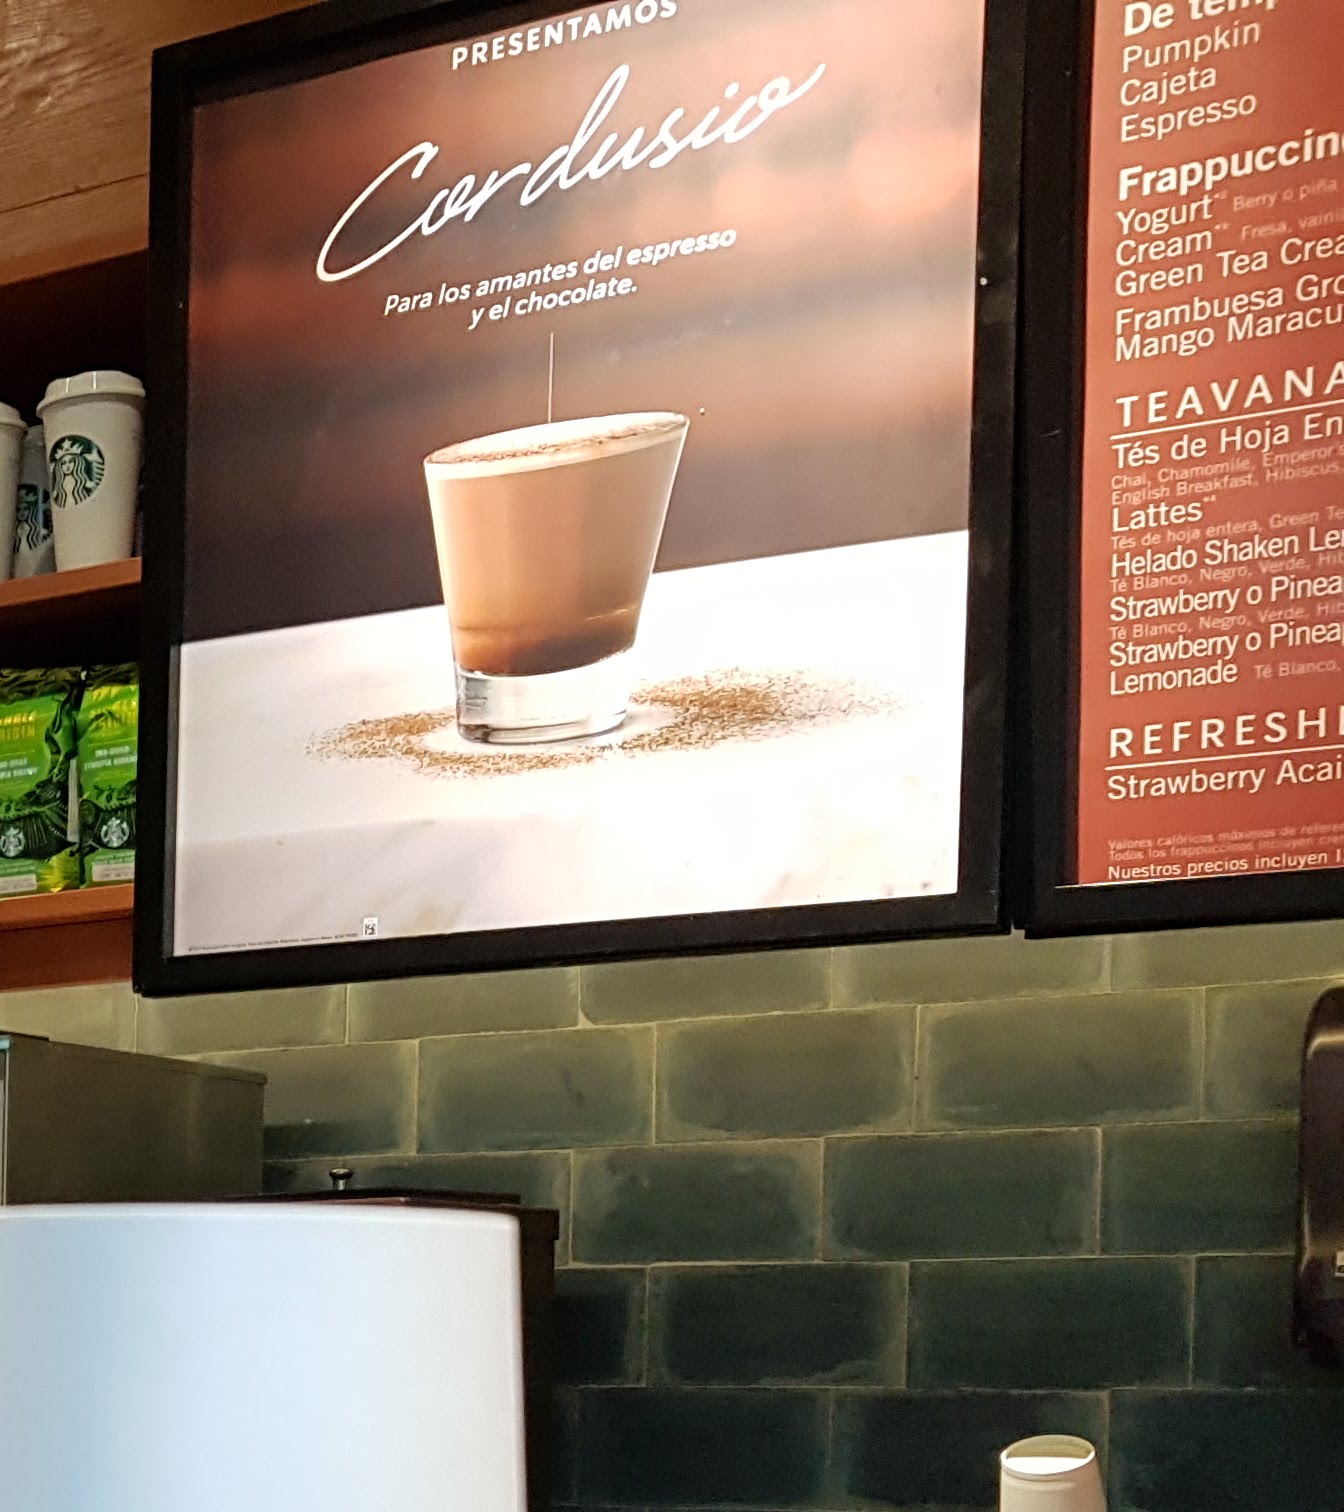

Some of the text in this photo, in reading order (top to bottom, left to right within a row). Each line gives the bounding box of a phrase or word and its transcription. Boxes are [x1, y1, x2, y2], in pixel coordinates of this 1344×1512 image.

[451, 0, 679, 70] PRESENTAMOS
[1124, 2, 1174, 37] De
[1122, 20, 1261, 73] Pumpkin
[1120, 67, 1217, 106] Cajeta
[1120, 94, 1257, 142] Espresso
[315, 63, 827, 282] Cordusio
[1118, 129, 1344, 201] Frappuccin
[1116, 194, 1213, 235] Yogurt
[1116, 230, 1212, 266] Cream
[384, 228, 738, 317] Para los amantes del espresso
[1115, 263, 1203, 297] Green
[1216, 250, 1268, 278] Tea
[469, 274, 638, 330] y el chocolate.
[1116, 287, 1284, 335] Frambuesa
[1115, 326, 1215, 362] Mango
[1115, 361, 1344, 427] TEAVANA
[1111, 442, 1160, 469] Tés
[1170, 434, 1207, 460] de
[1220, 421, 1289, 453] Hoja
[1112, 501, 1202, 532] Lattes
[1111, 545, 1197, 577] Helado
[1204, 534, 1299, 566] Shaken
[1309, 526, 1344, 552] Le
[1110, 587, 1240, 622] Strawberry
[1246, 585, 1262, 605] o
[1109, 621, 1344, 667] Strawberry o Pinea
[1110, 660, 1238, 696] Lemonade
[1107, 768, 1266, 800] Strawberry
[1108, 851, 1328, 880] Nuestros precios incluyen
